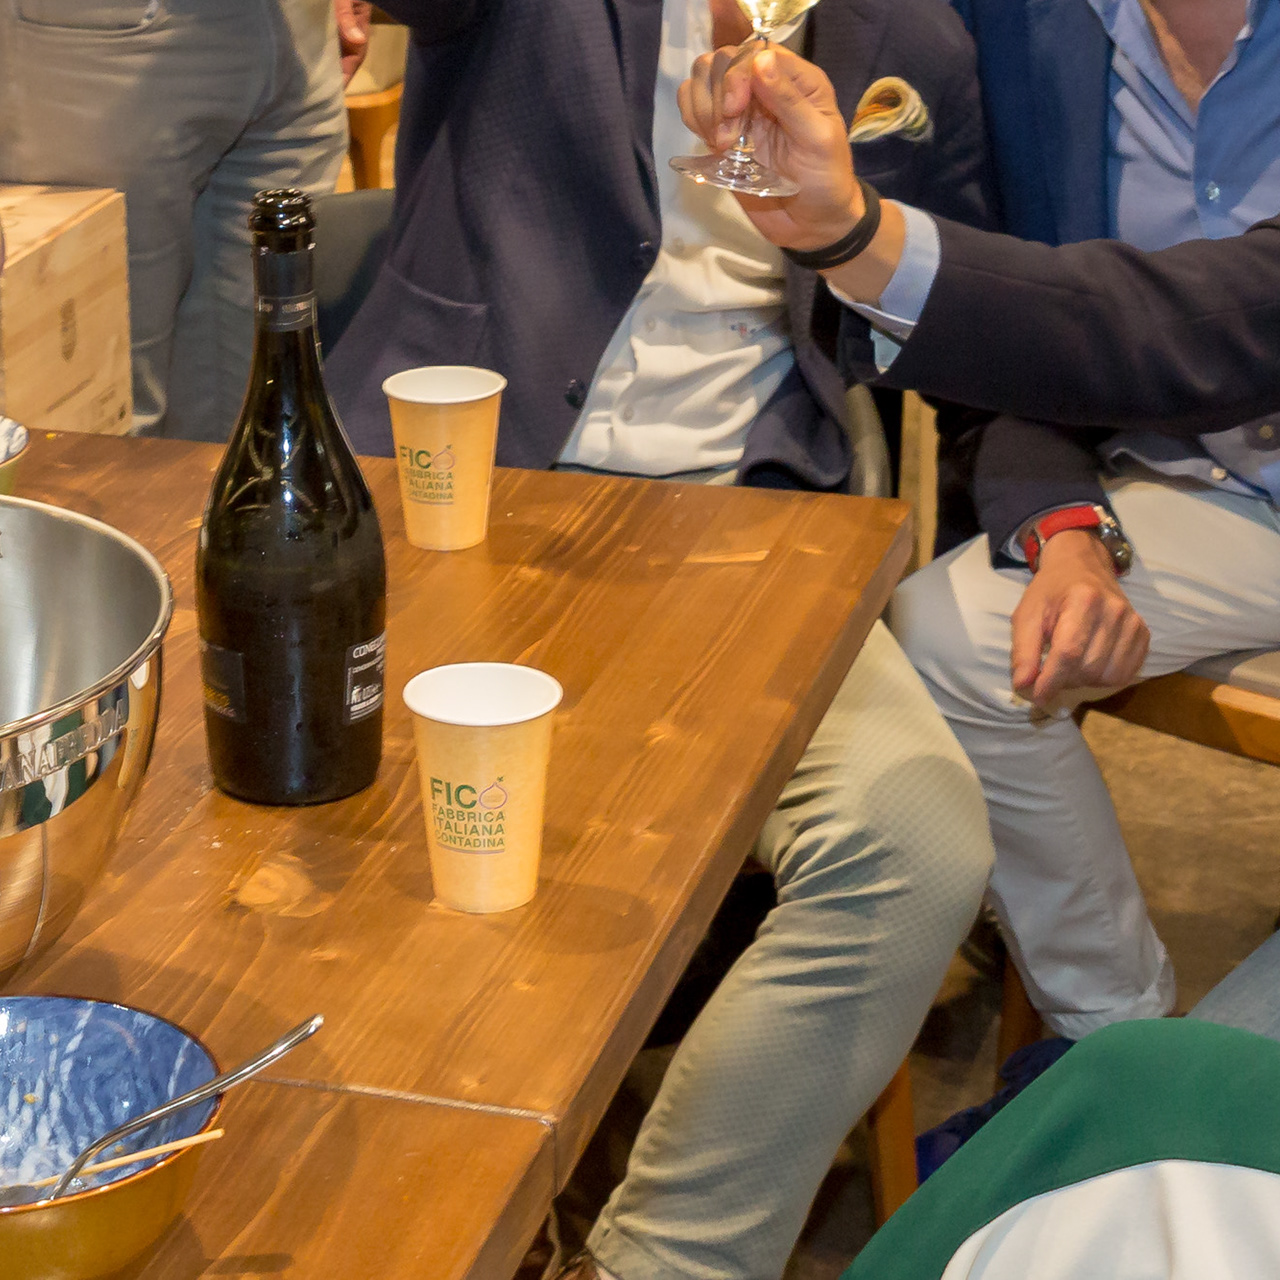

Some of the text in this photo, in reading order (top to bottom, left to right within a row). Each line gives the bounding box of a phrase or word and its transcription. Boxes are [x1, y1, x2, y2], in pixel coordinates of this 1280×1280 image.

[433, 803, 505, 823] FABBRICA
[433, 815, 505, 836] ITALIANA
[435, 829, 505, 848] CONTADINA
